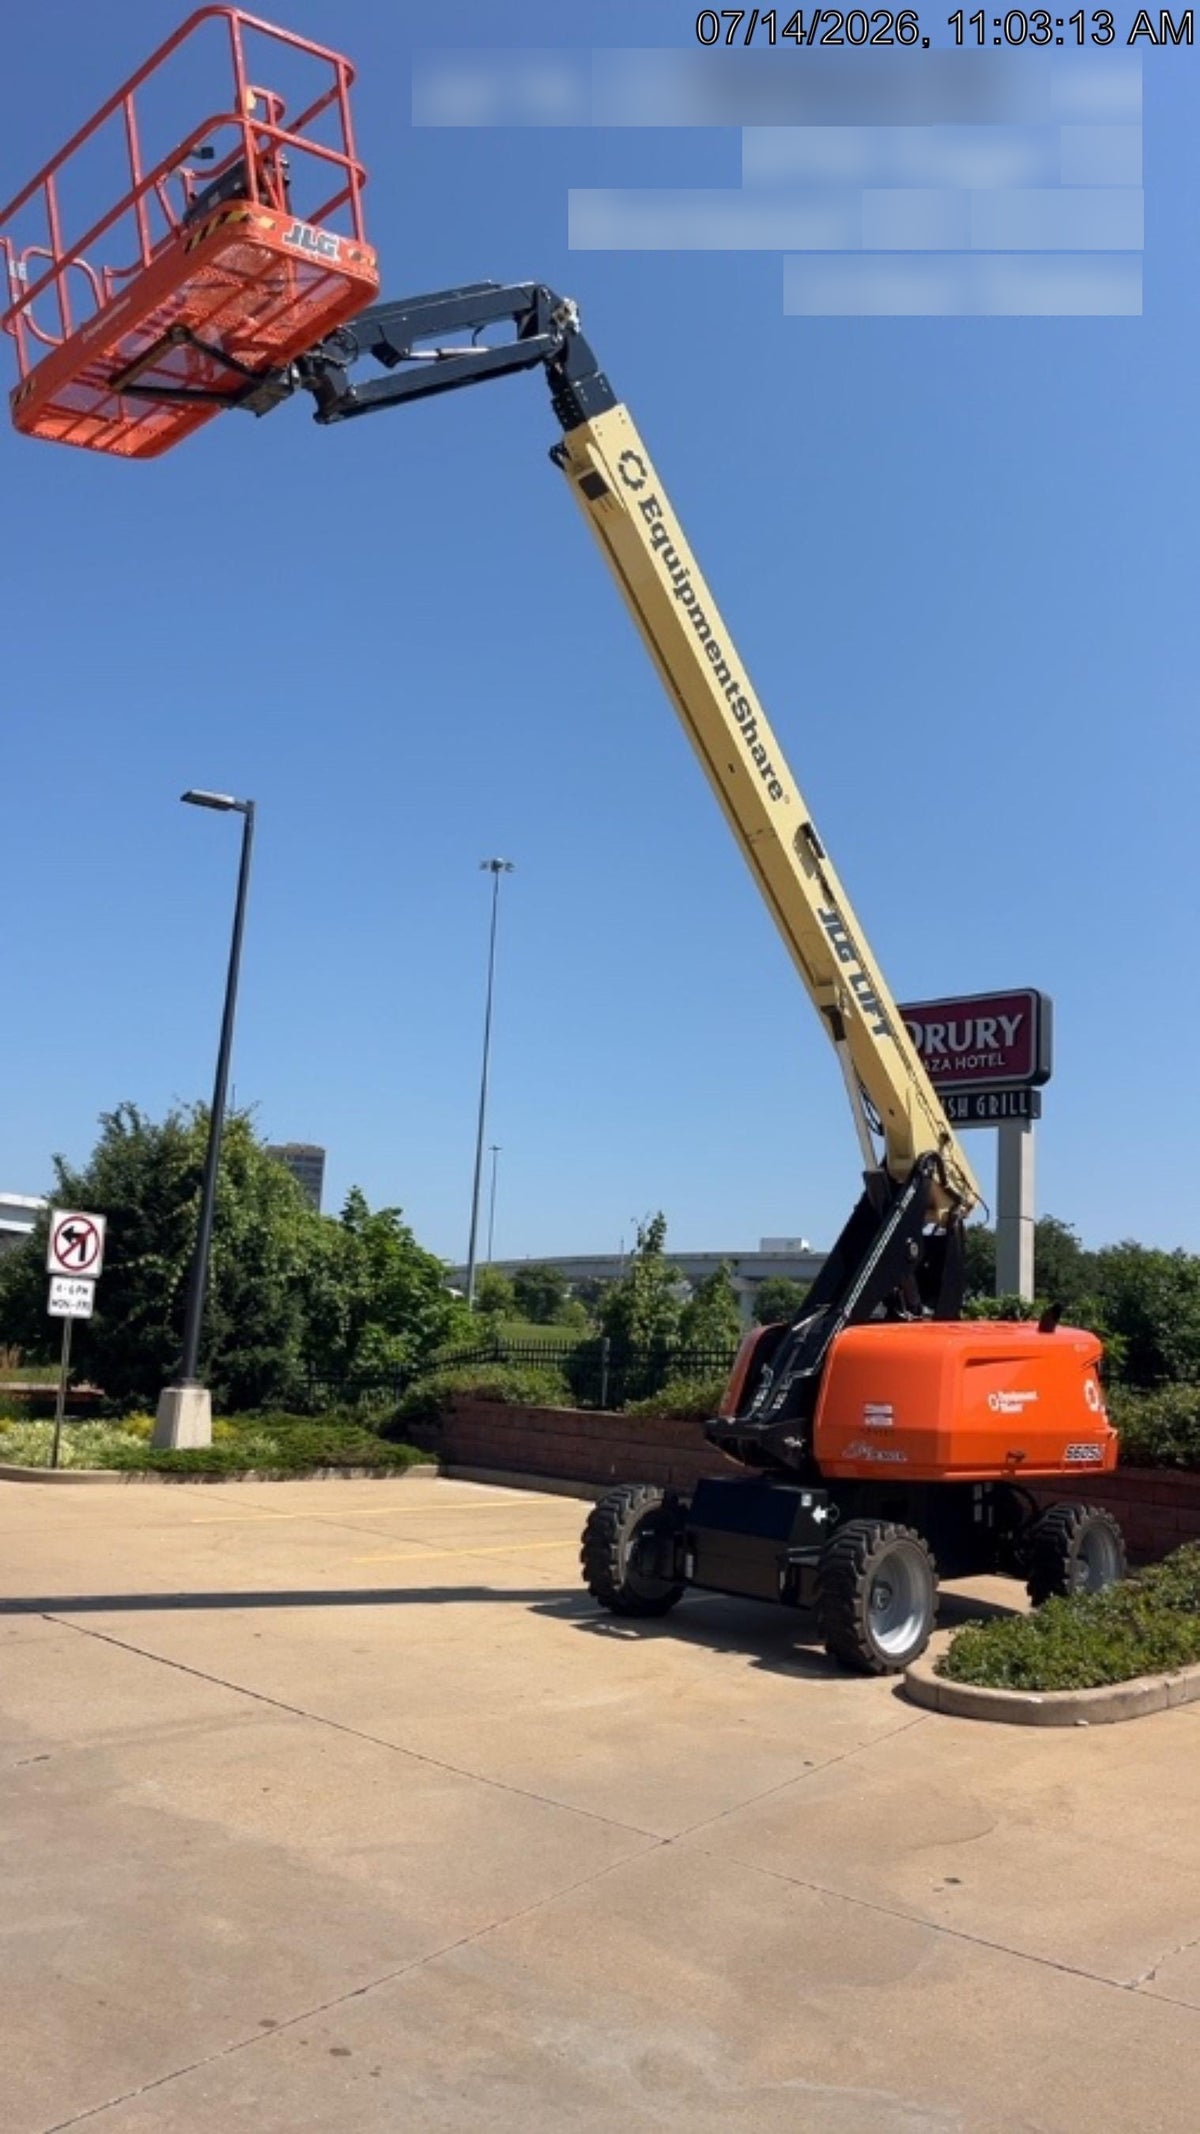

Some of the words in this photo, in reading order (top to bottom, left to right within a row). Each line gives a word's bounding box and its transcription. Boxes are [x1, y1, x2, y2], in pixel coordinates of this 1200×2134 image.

[283, 222, 340, 259] JLG
[638, 494, 784, 802] EquipmentShare
[817, 907, 859, 963] JLG
[848, 972, 893, 1036] LIFT
[955, 1052, 1006, 1070] HOTEL
[942, 1096, 969, 1118] SH
[976, 1092, 1028, 1116] GRILL
